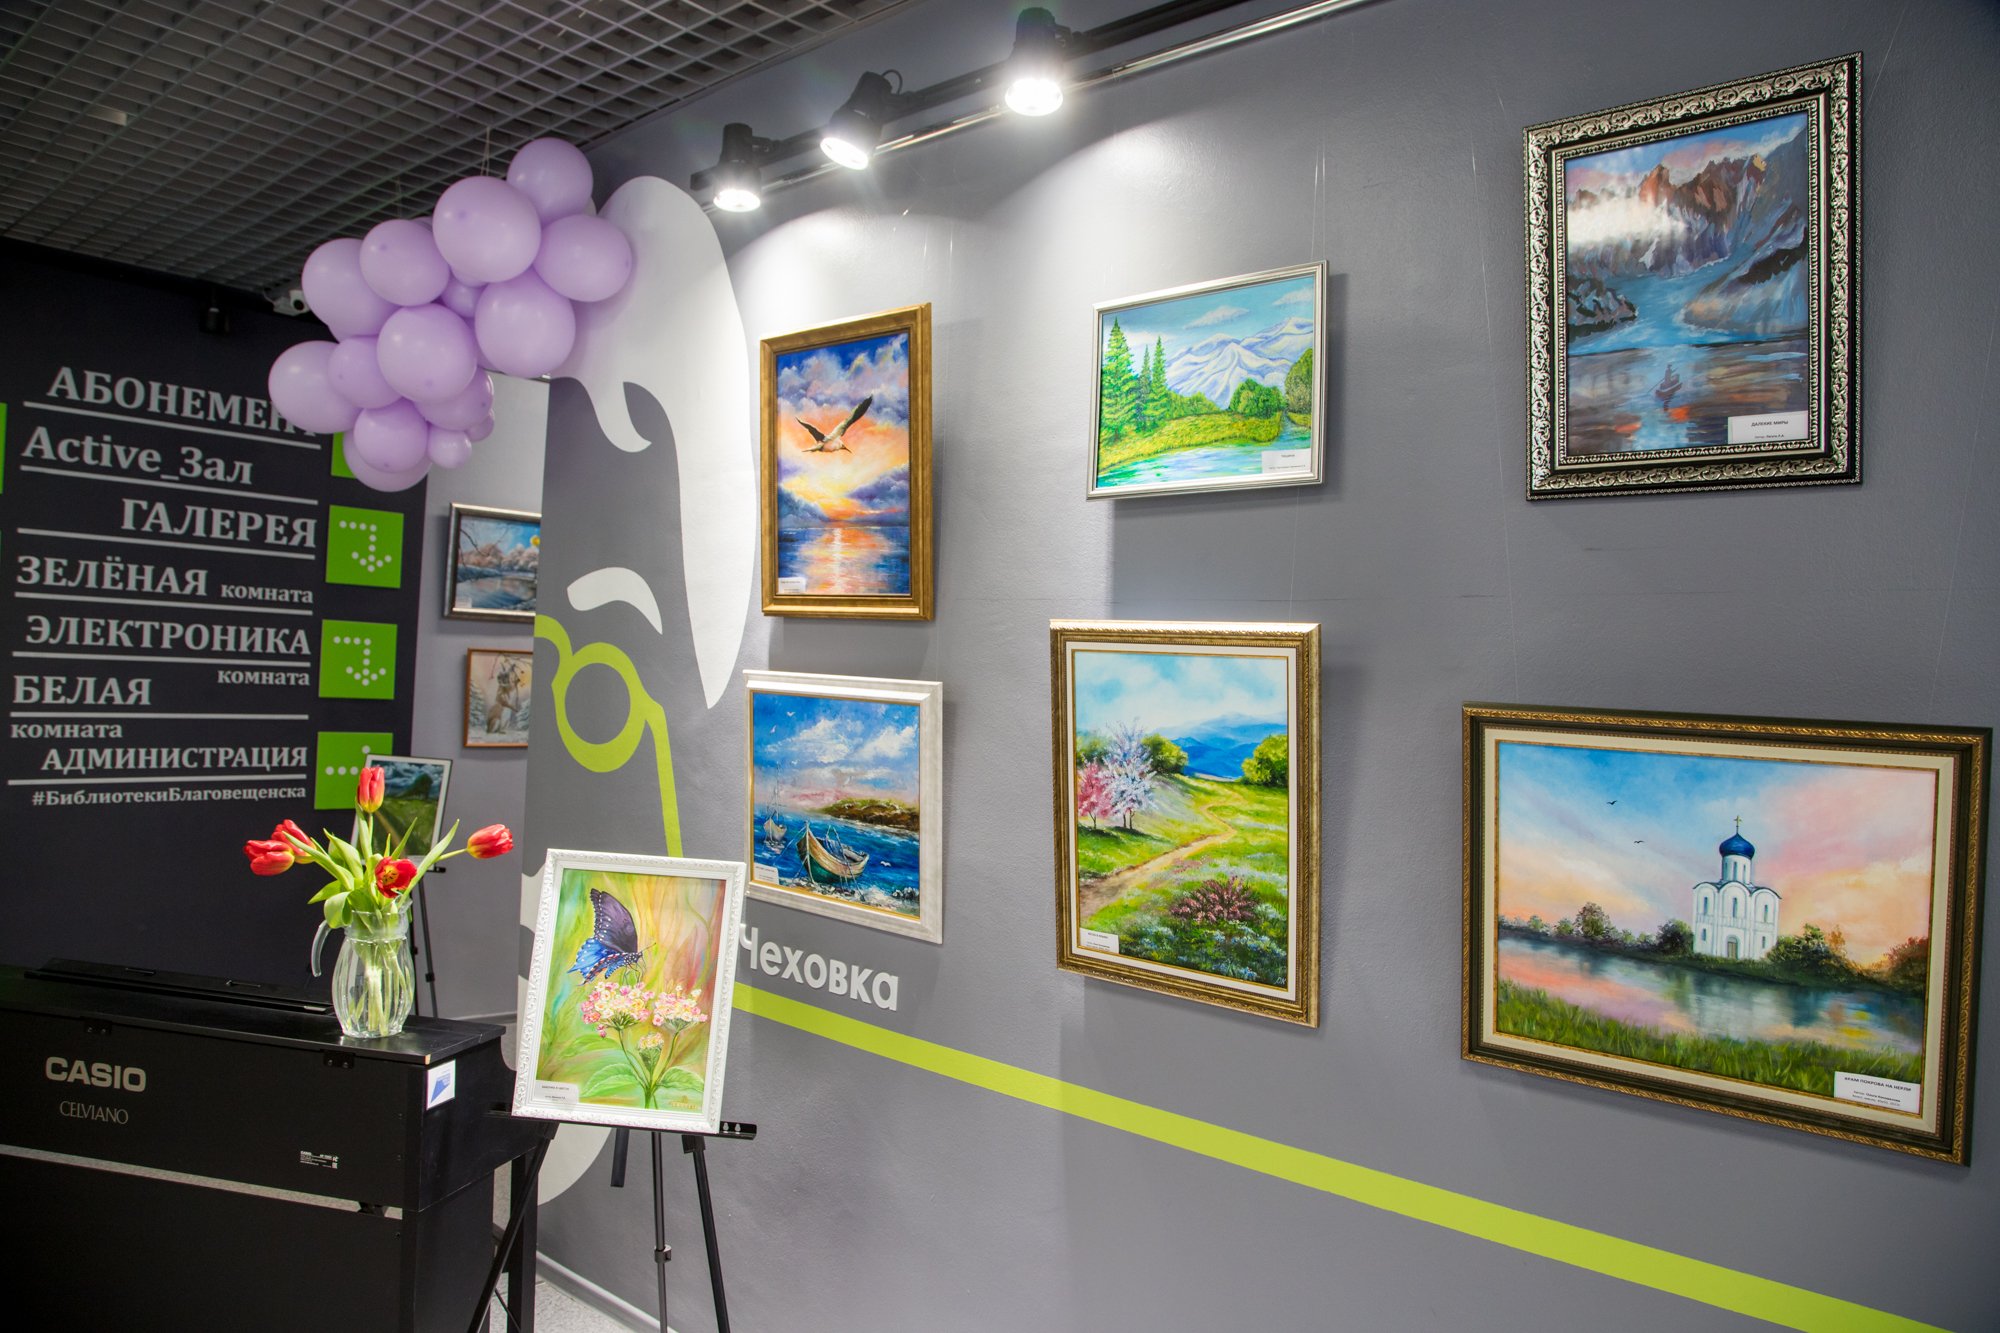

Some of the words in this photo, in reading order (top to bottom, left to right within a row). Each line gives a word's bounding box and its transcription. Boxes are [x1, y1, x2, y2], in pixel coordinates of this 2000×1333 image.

[46, 366, 316, 437] АБОНЕМЕН
[21, 426, 252, 484] Active_Зал
[121, 498, 317, 548] ГАЛЕРЕЯ
[17, 555, 208, 597] ЗЕЛЁНАЯ
[220, 582, 314, 604] комната
[25, 615, 312, 655] ЭЛЕКТРОНИКА
[13, 675, 151, 706] БЕЛАЯ
[217, 669, 311, 687] комната
[11, 721, 123, 739] комната
[41, 747, 308, 775] АДМИНИСТРАЦИЯ
[32, 785, 307, 807] #БиблиотекиБлаговещенска
[740, 923, 899, 1011] Чеховка
[45, 1055, 147, 1093] CASIO
[59, 1100, 129, 1125] CELVIANO
